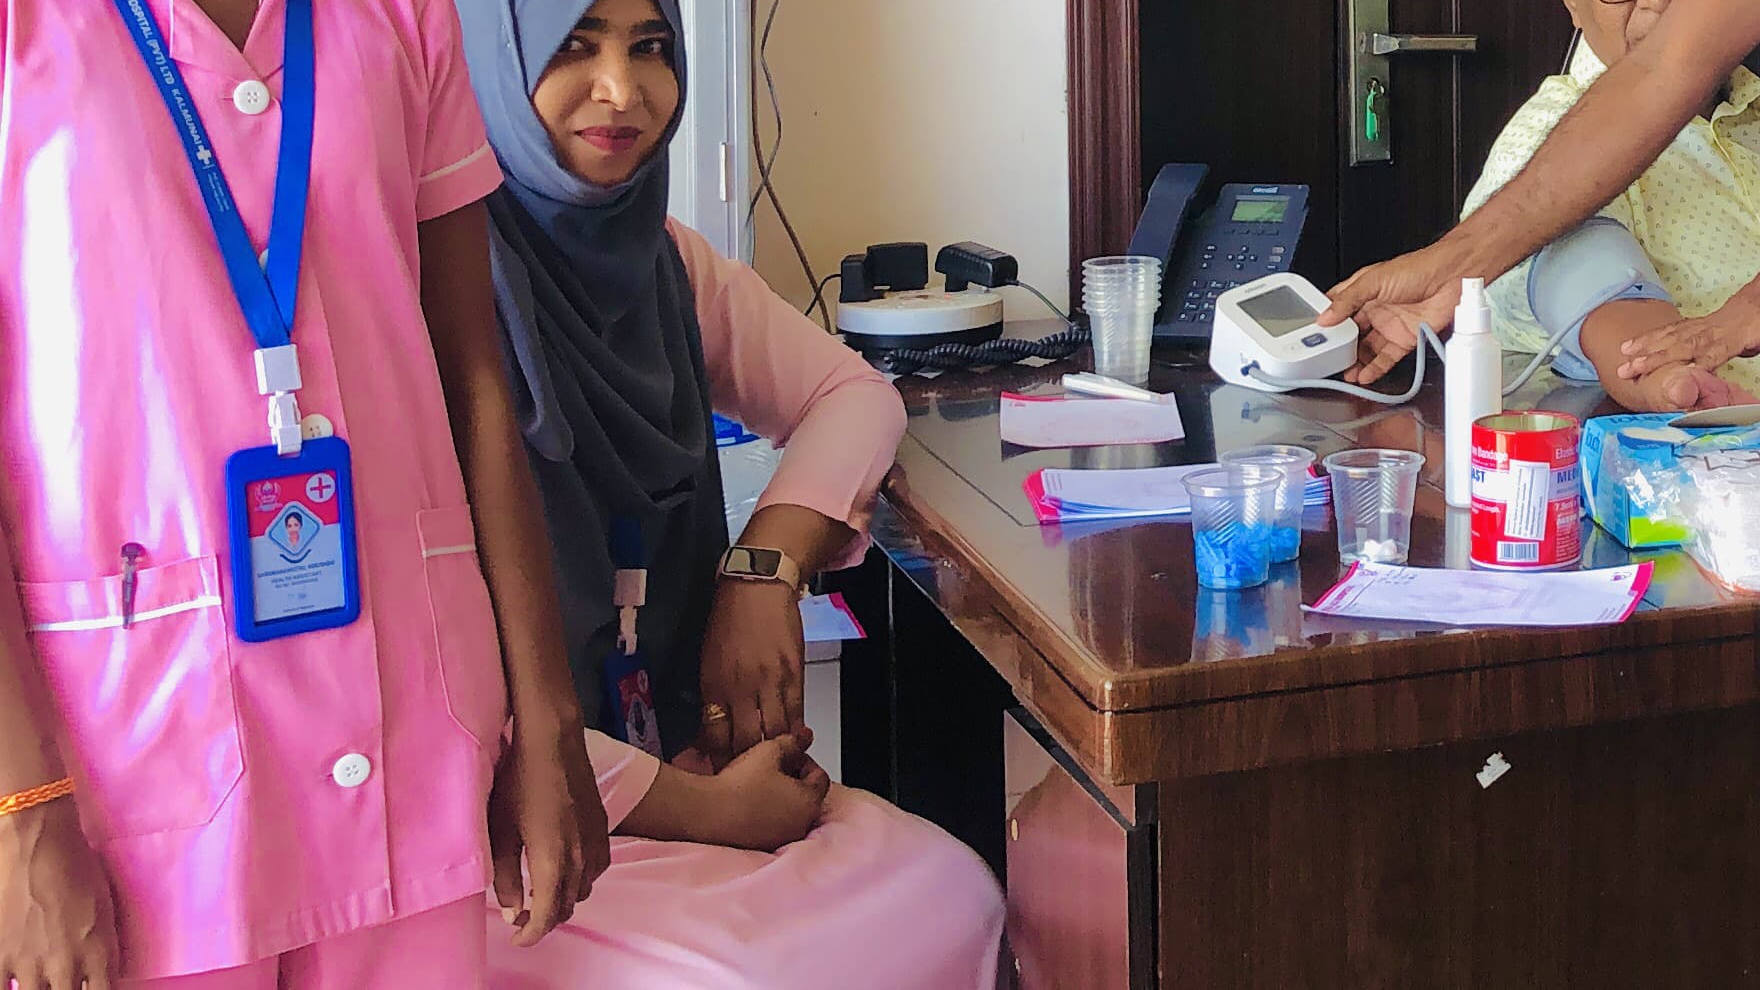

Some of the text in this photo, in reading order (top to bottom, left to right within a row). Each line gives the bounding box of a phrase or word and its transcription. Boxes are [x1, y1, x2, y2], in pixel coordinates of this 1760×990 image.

[146, 39, 167, 65] (PVT)
[160, 66, 175, 85] LTD
[171, 88, 202, 146] KALMUNAI
